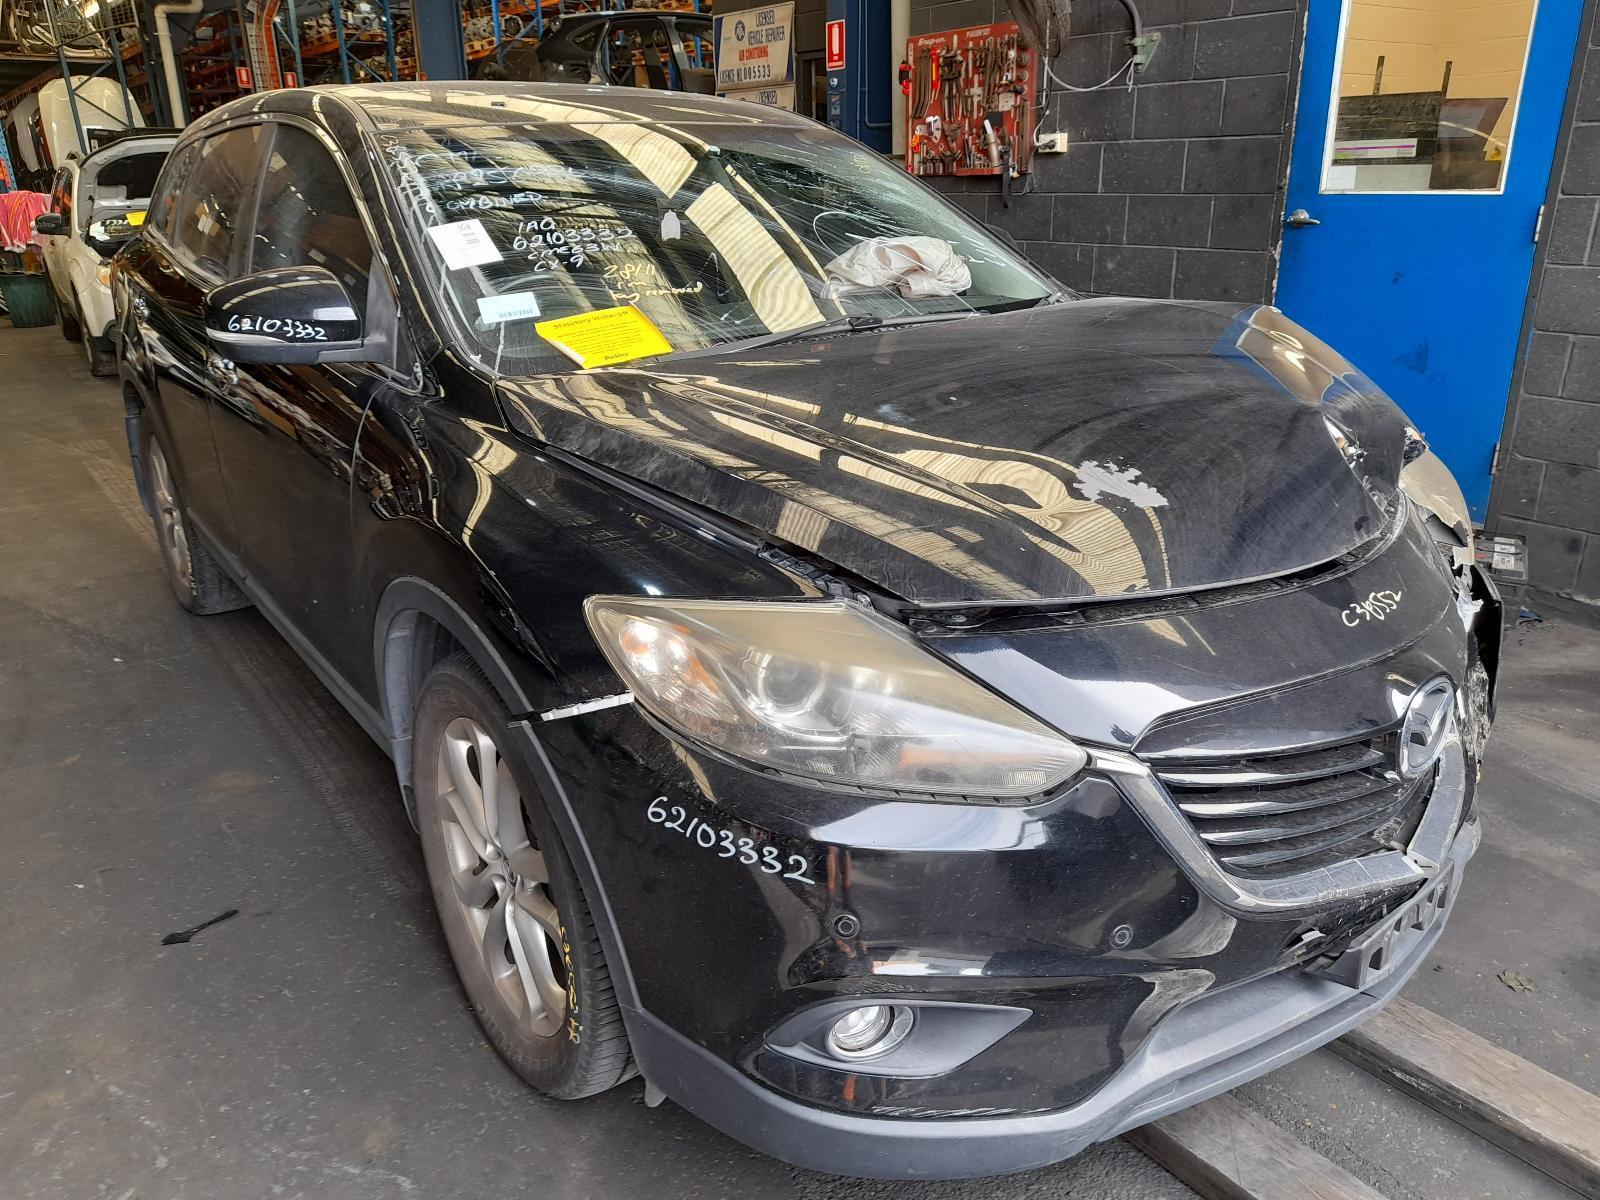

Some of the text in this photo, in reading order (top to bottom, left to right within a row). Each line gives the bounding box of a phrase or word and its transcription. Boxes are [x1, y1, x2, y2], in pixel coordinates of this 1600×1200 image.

[755, 10, 775, 27] LICENSED
[748, 26, 785, 46] VEHICLE REPAIRER
[512, 227, 638, 250] 62103332
[228, 314, 328, 340] 62103332
[553, 318, 591, 330] Statutory
[647, 796, 816, 885] 62103332
